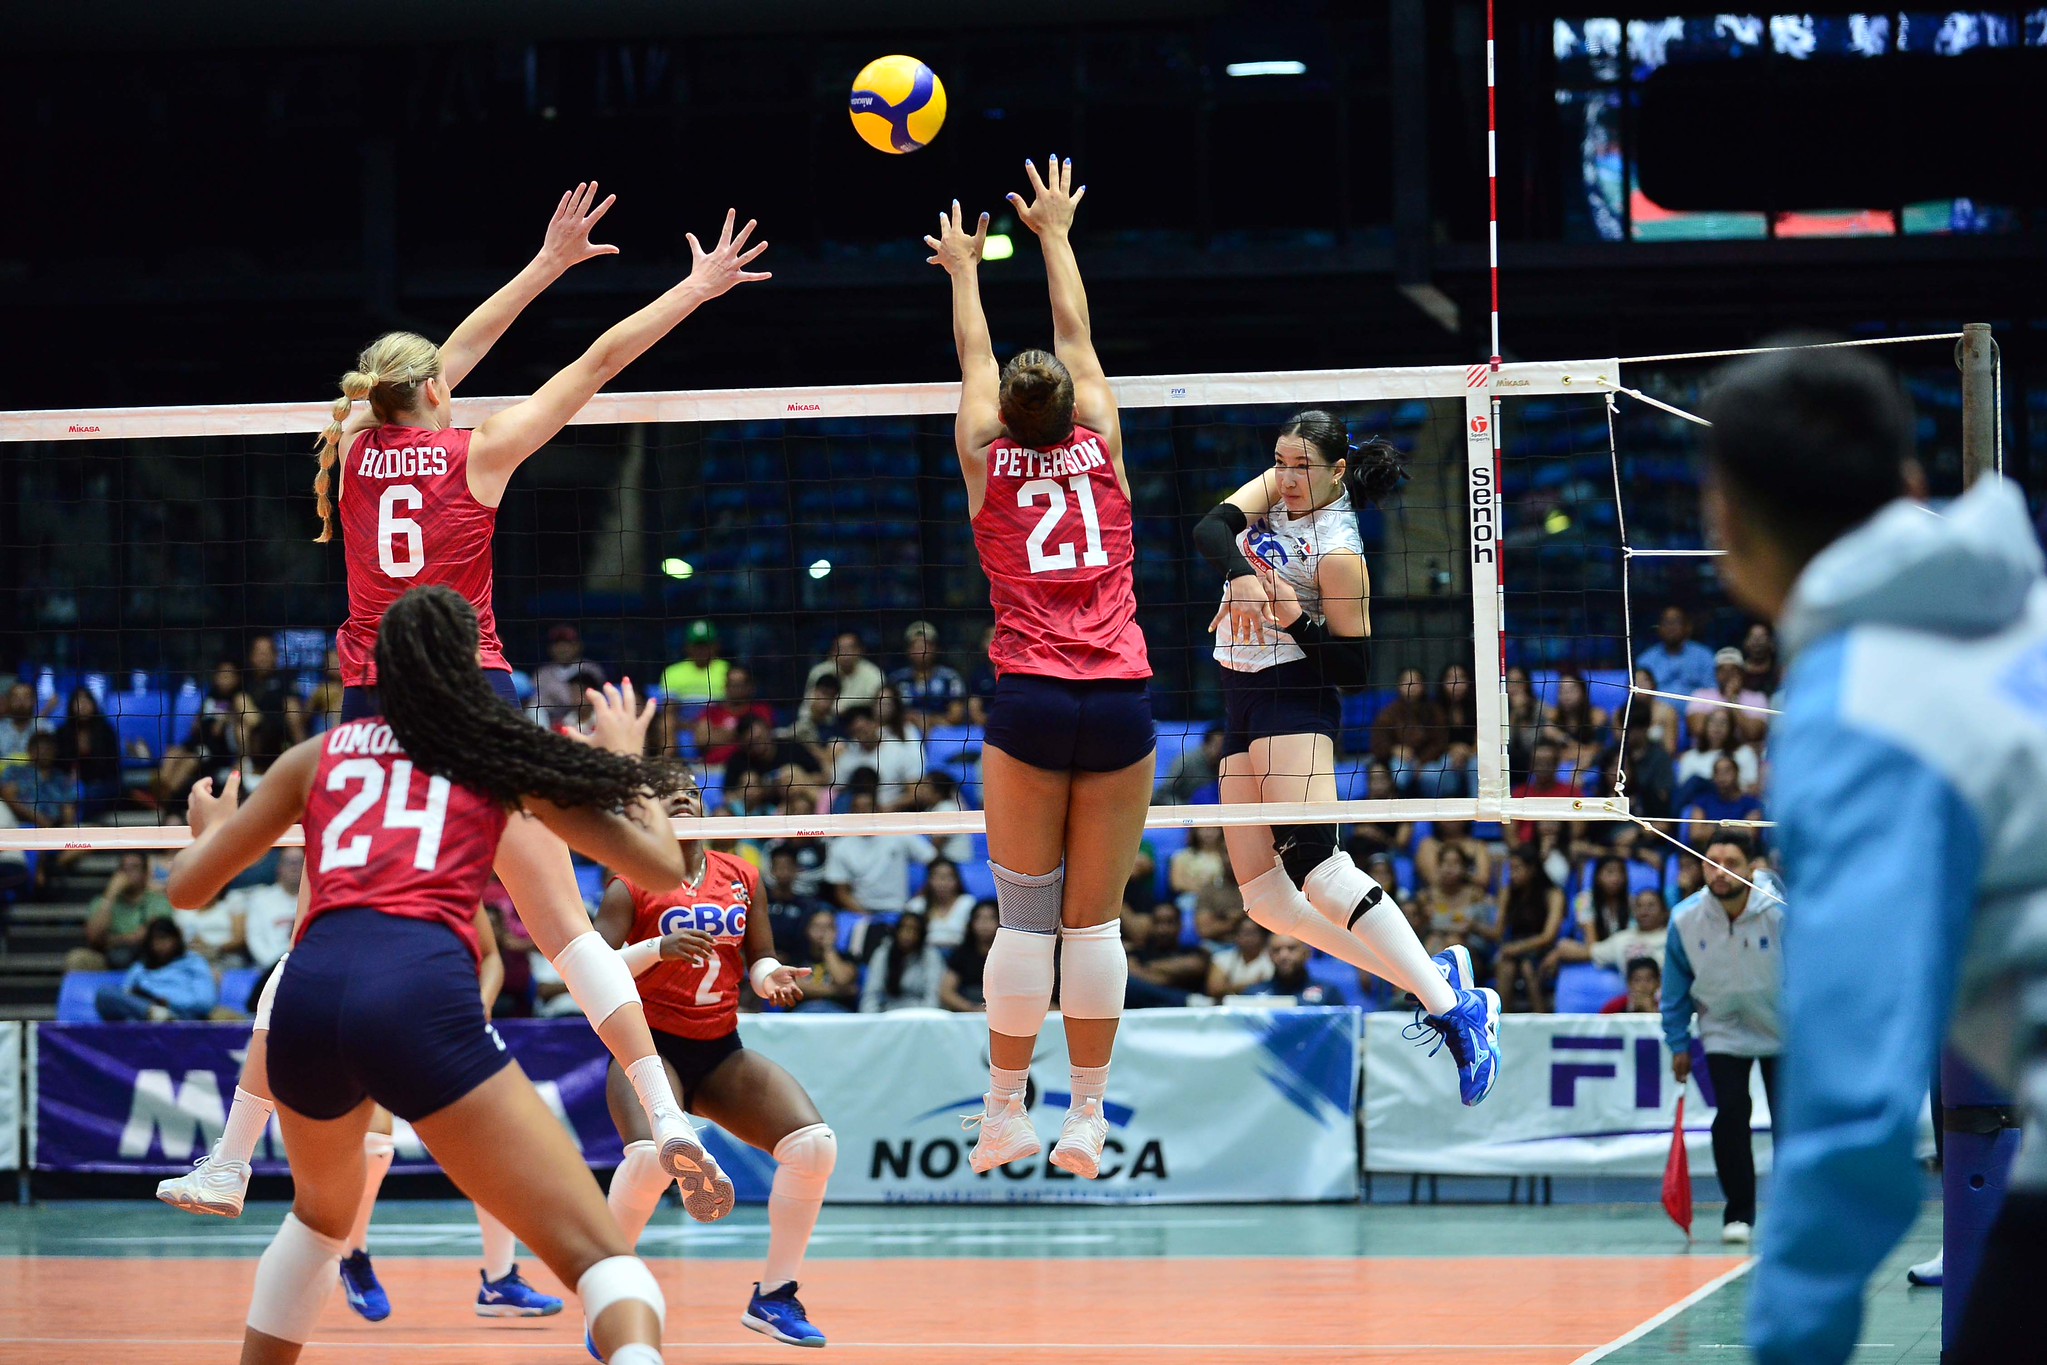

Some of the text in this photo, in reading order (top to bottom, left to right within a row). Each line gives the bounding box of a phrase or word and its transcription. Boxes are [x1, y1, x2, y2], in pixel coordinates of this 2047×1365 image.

[787, 402, 820, 411] MiKASA
[68, 423, 100, 432] MiKASA
[358, 446, 449, 479] HODGES
[993, 437, 1106, 478] PETERSON
[378, 484, 425, 578] 6
[1016, 473, 1109, 574] 21
[327, 722, 406, 756] OMO
[319, 758, 451, 874] 24
[658, 903, 747, 938] GBC
[691, 948, 724, 1006] 2
